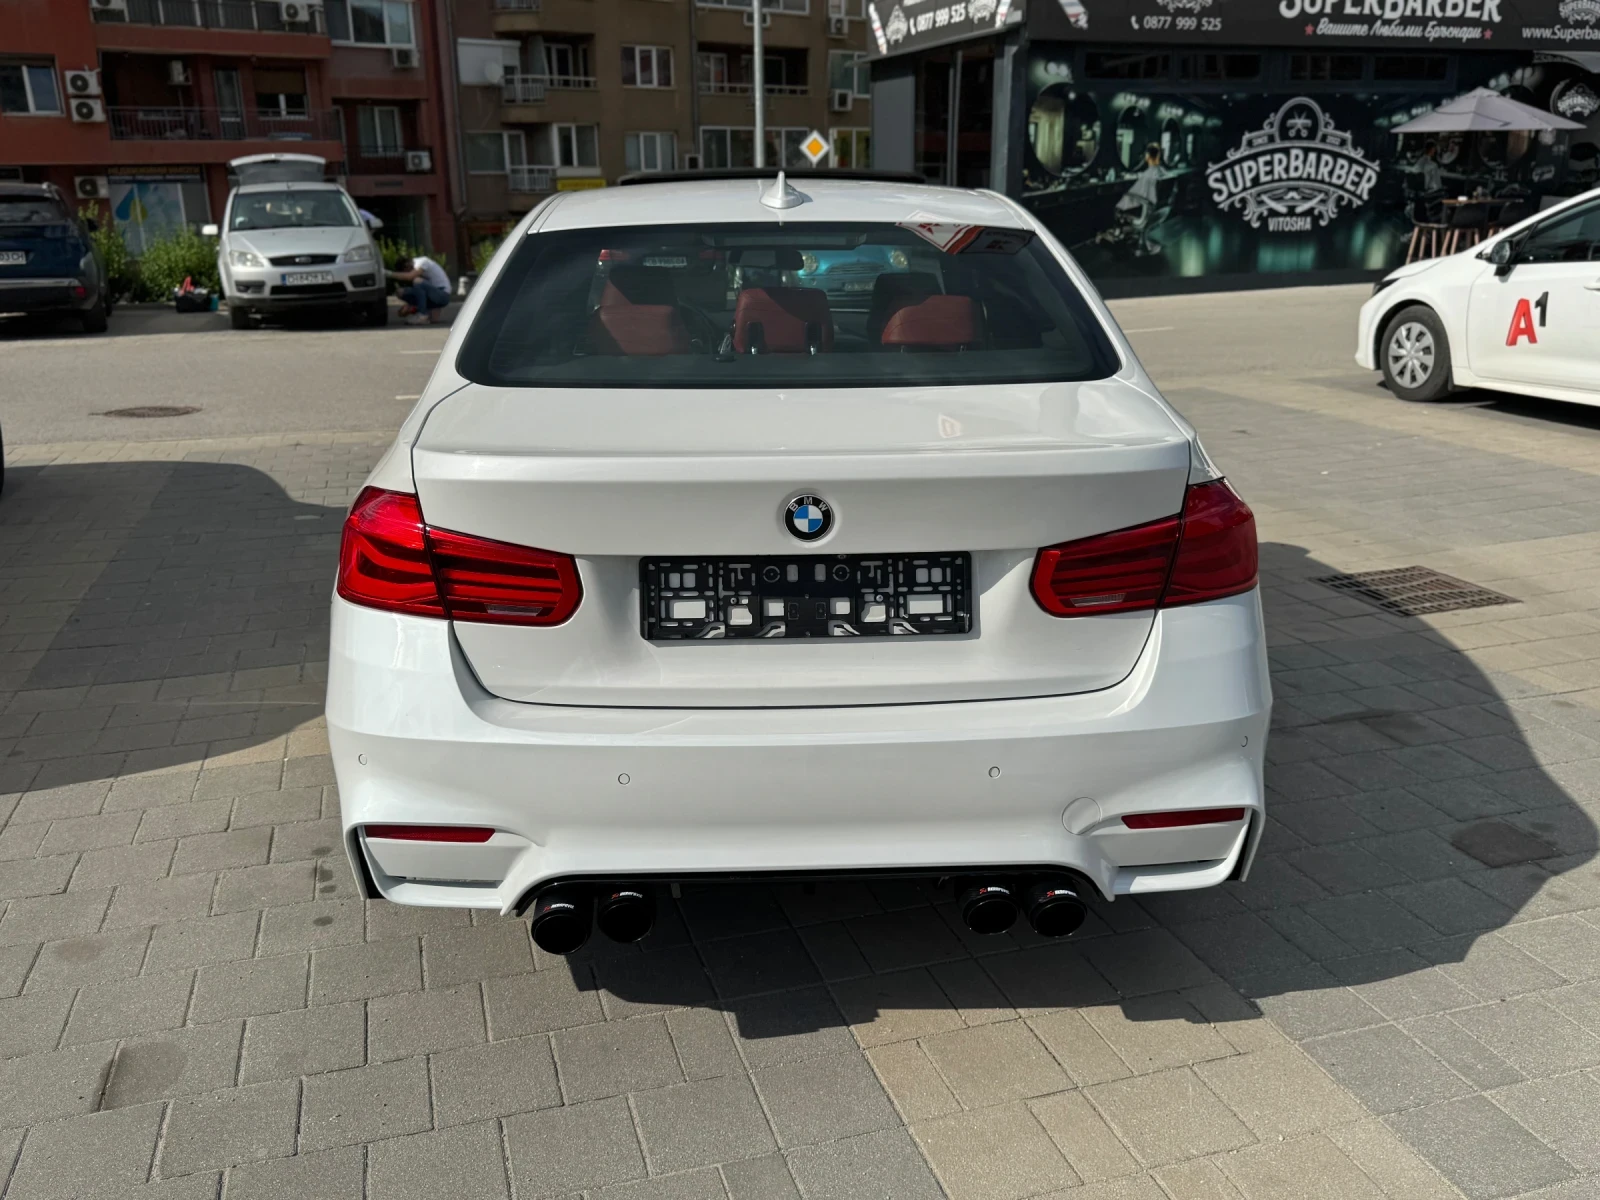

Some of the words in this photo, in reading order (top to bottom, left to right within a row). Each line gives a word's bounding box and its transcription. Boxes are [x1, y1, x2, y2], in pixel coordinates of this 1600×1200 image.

[916, 12, 934, 32] 0877
[935, 7, 949, 28] 999
[951, 2, 966, 24] 525
[1143, 16, 1172, 30] 0877
[1176, 16, 1197, 31] 999
[1201, 17, 1222, 31] 525
[1316, 17, 1369, 36] Вашите
[1207, 148, 1377, 202] SUPERBARBER
[1268, 216, 1312, 232] VITOSHA
[1506, 291, 1549, 346] A1
[789, 496, 829, 512] BMW
